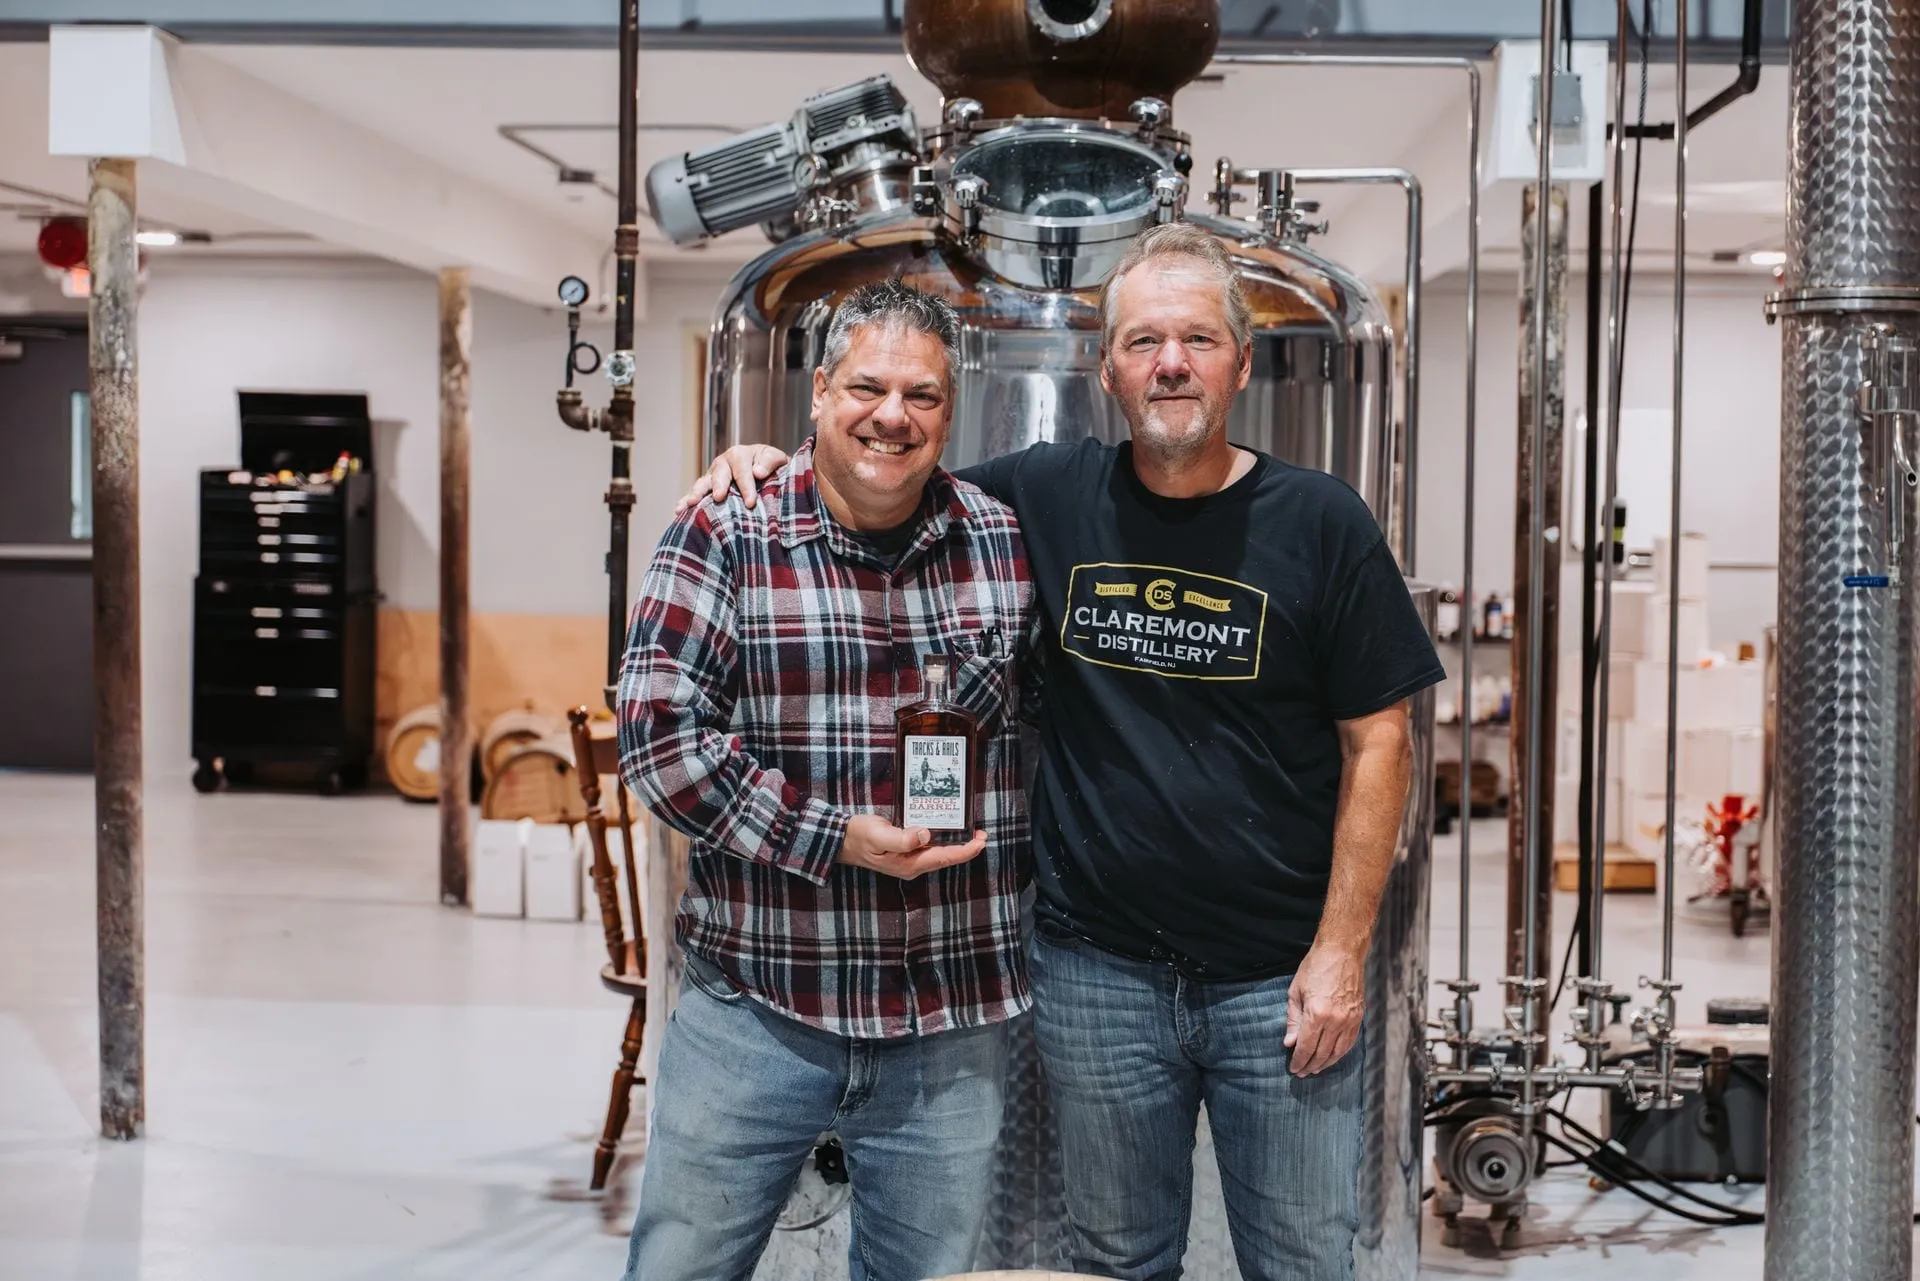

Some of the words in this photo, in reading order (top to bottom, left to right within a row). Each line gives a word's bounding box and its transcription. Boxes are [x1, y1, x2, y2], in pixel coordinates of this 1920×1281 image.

[1154, 590, 1172, 600] DS
[1189, 594, 1224, 609] EXCELLENCE
[1074, 606, 1250, 647] CLAREMONT
[1098, 633, 1218, 664] DISTILLERY
[912, 741, 934, 756] TRACKS
[936, 741, 941, 756] &
[942, 741, 959, 756] RAILS
